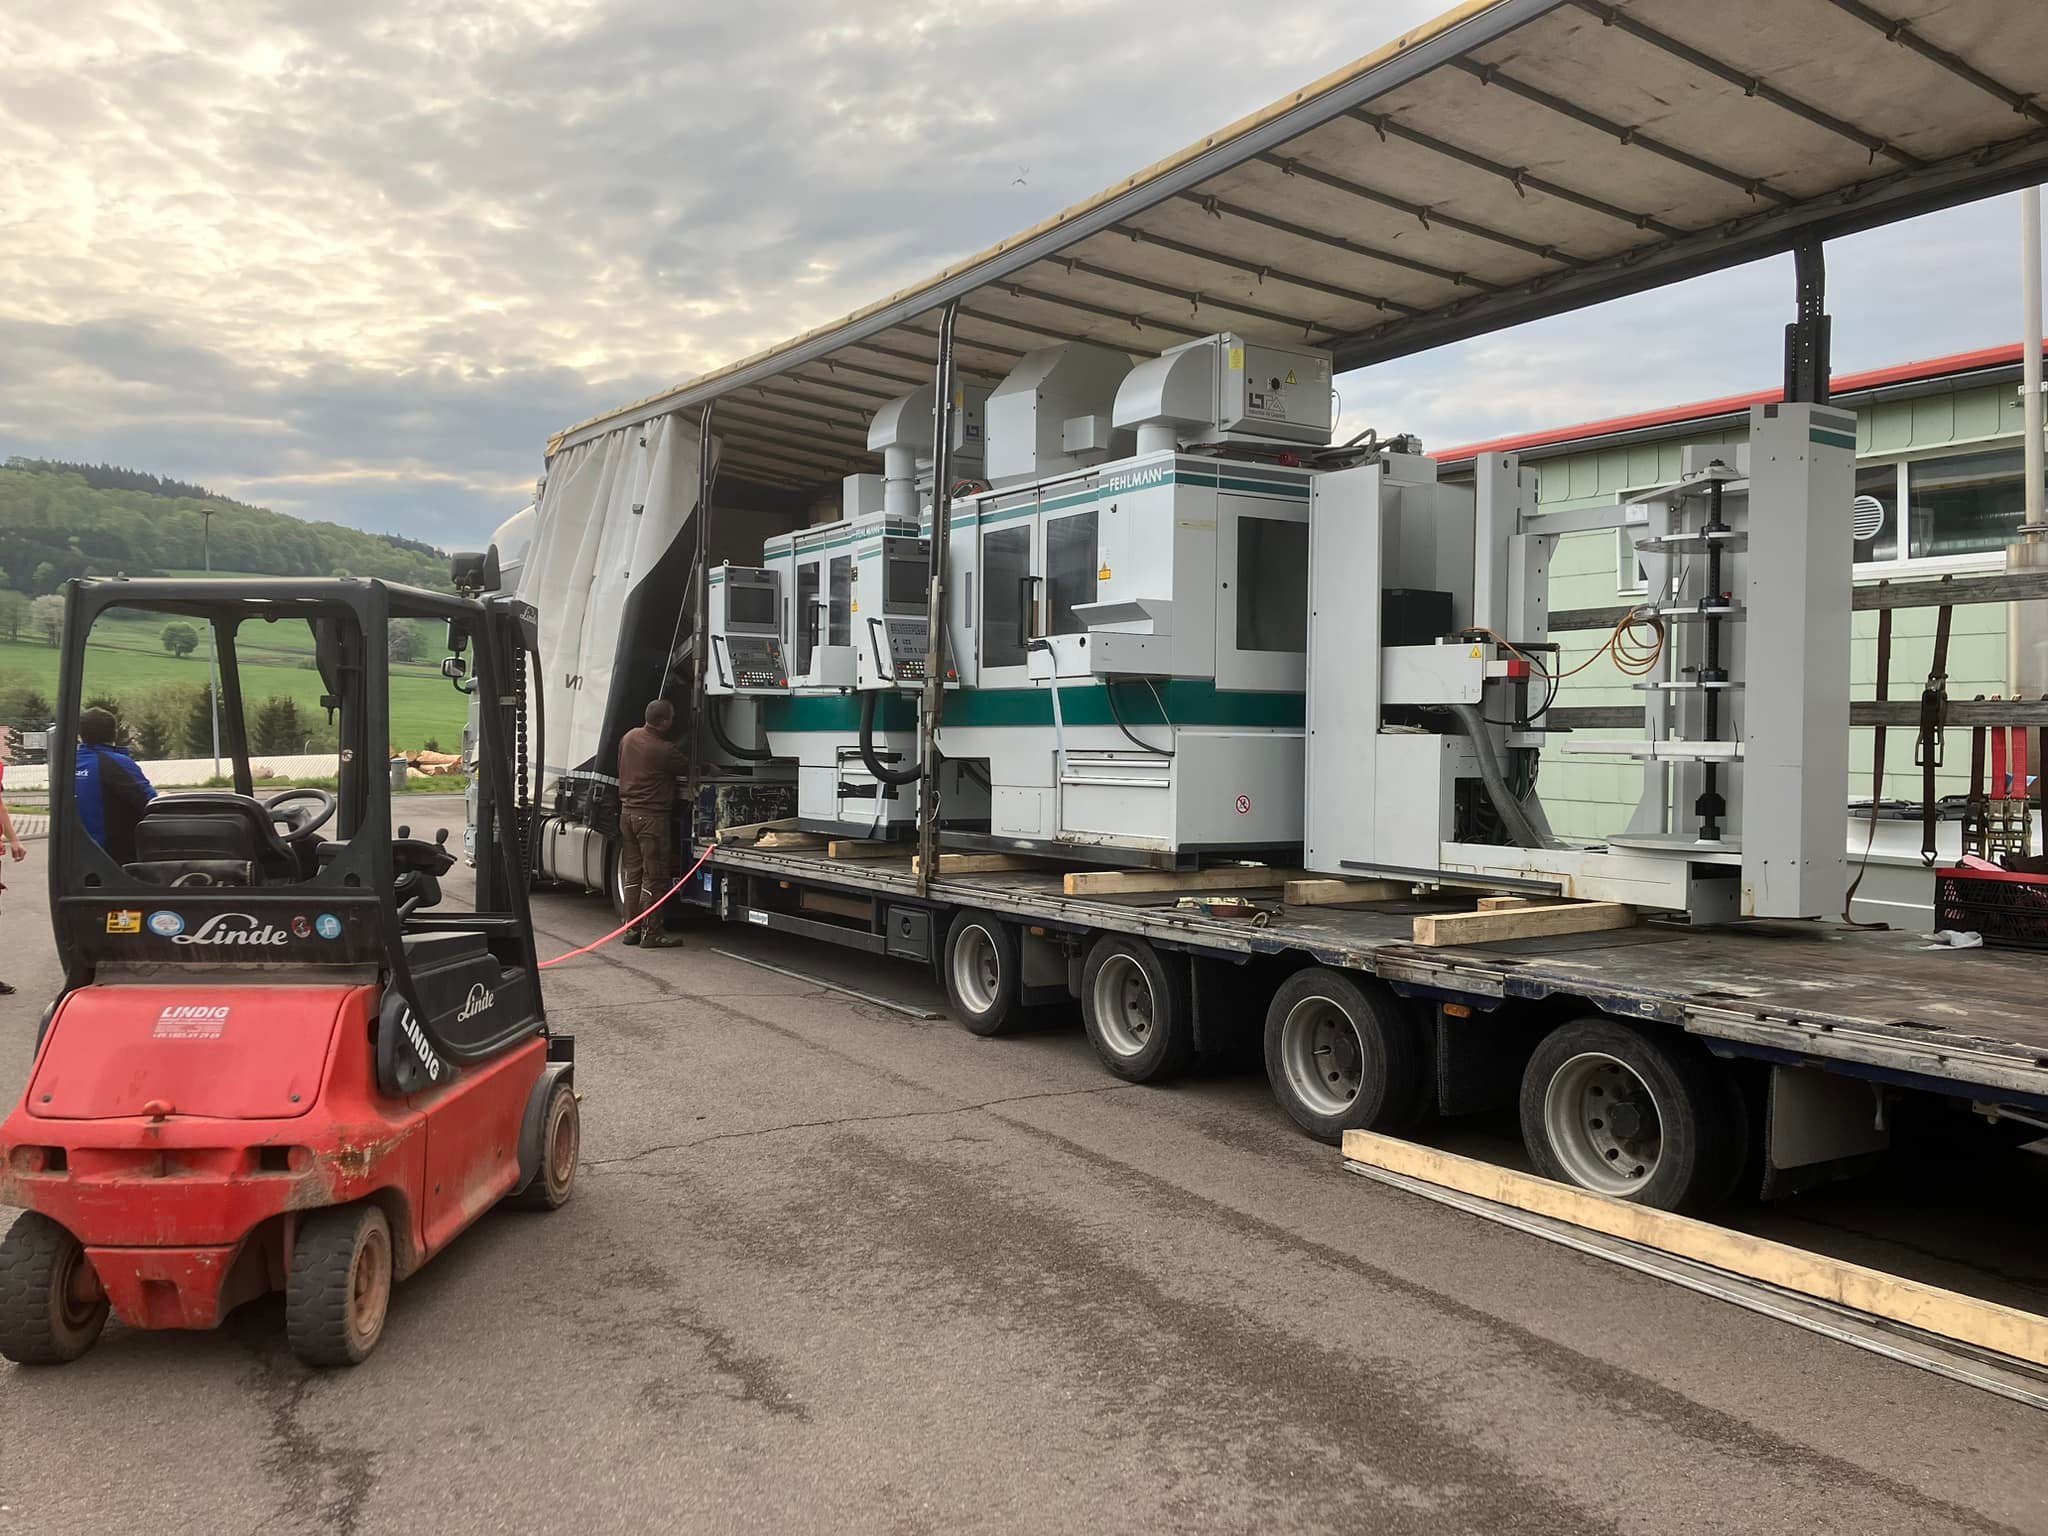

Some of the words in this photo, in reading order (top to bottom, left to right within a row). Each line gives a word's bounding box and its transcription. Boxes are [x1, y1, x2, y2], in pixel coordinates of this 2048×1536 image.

[1109, 467, 1162, 492] FEHLMANN
[171, 913, 289, 945] Linde
[160, 1006, 230, 1018] LINDIG
[457, 983, 494, 1022] Linde
[401, 1007, 440, 1080] LINDIG
